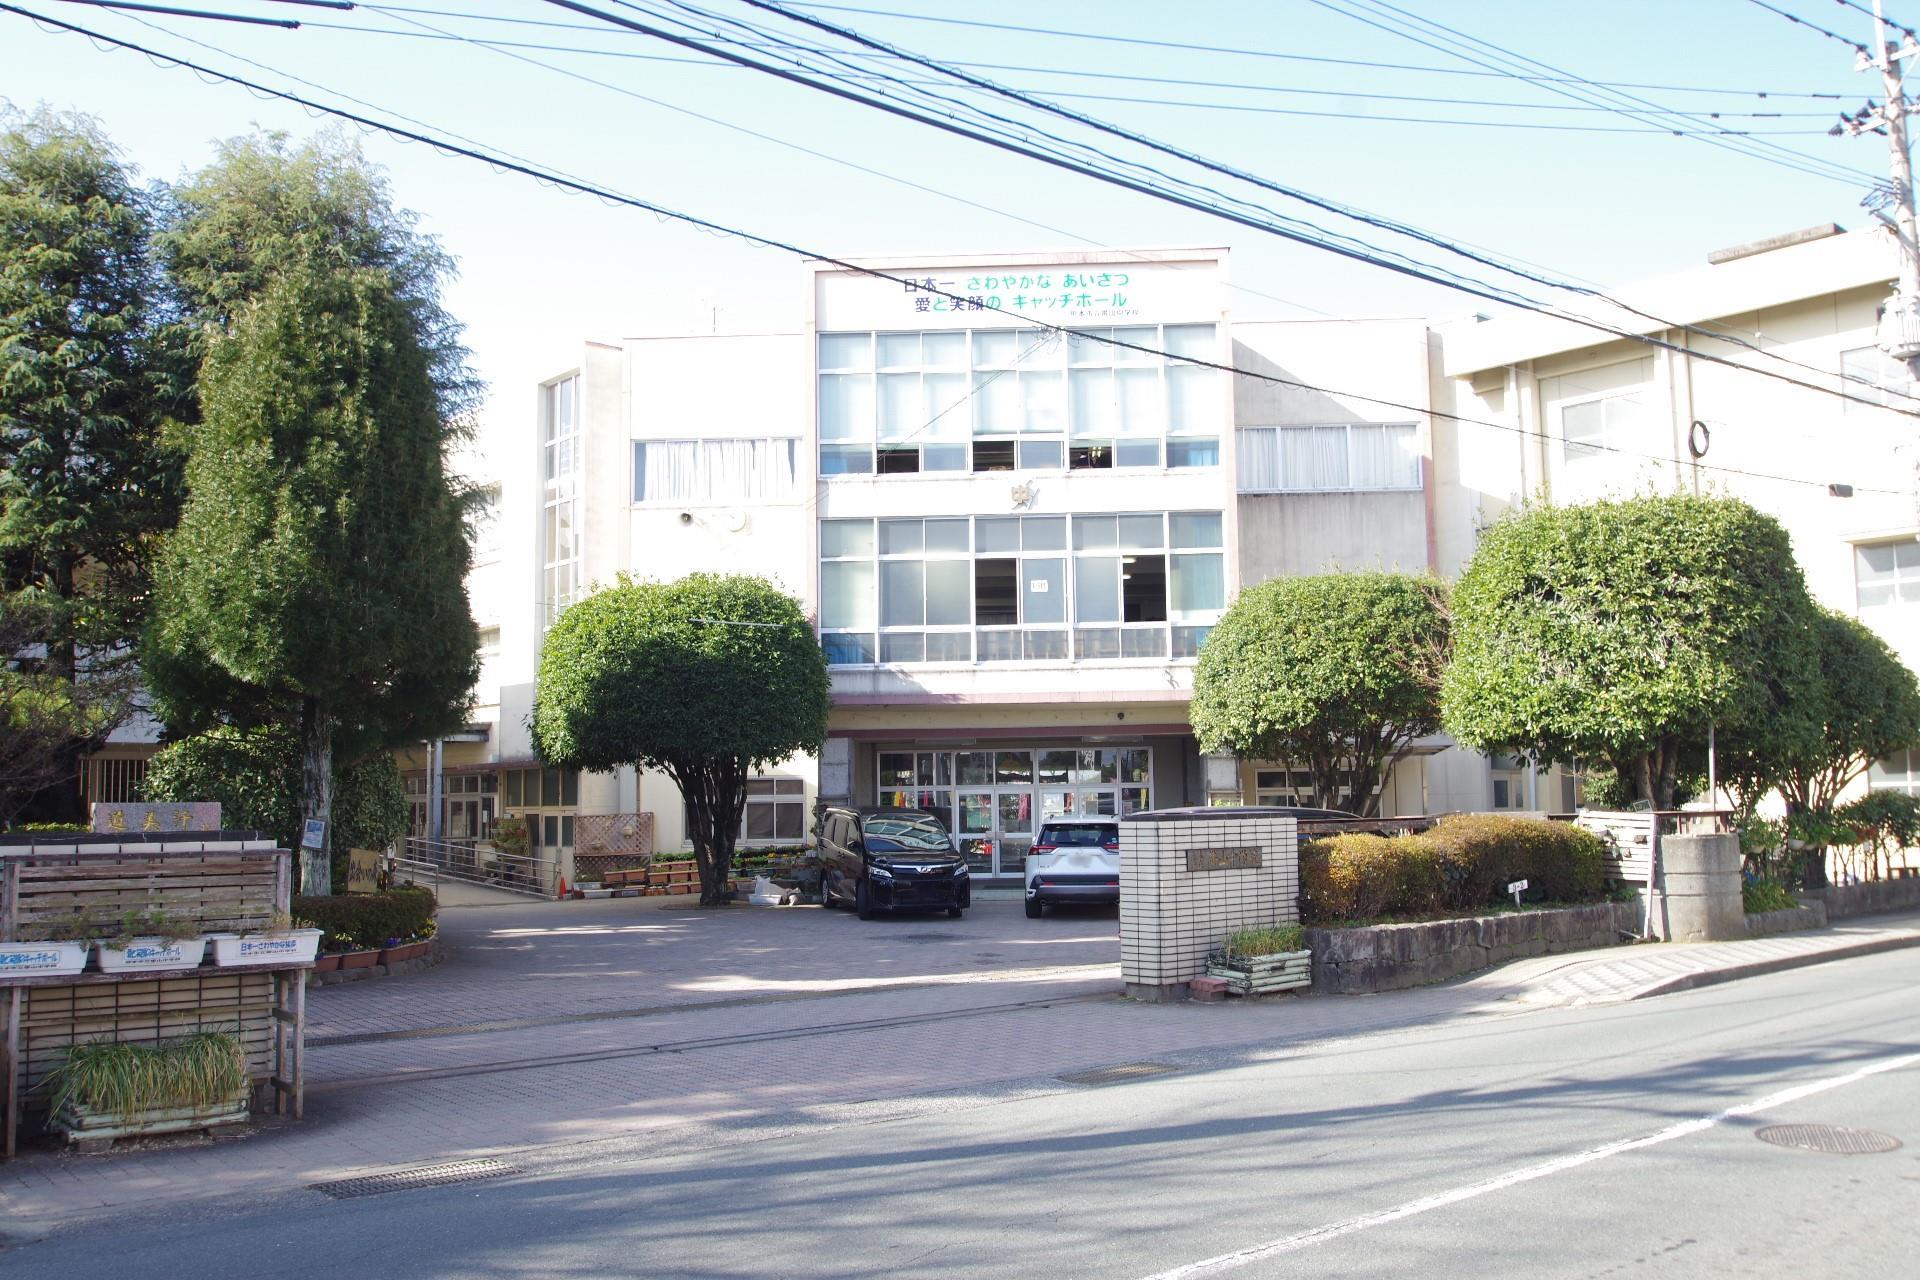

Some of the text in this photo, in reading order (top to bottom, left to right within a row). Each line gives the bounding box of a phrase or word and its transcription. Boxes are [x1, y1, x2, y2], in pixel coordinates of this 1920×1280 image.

[904, 273, 1129, 293] 日本一 さわやかな あいさつ
[915, 296, 1001, 312] 愛と笑顔の
